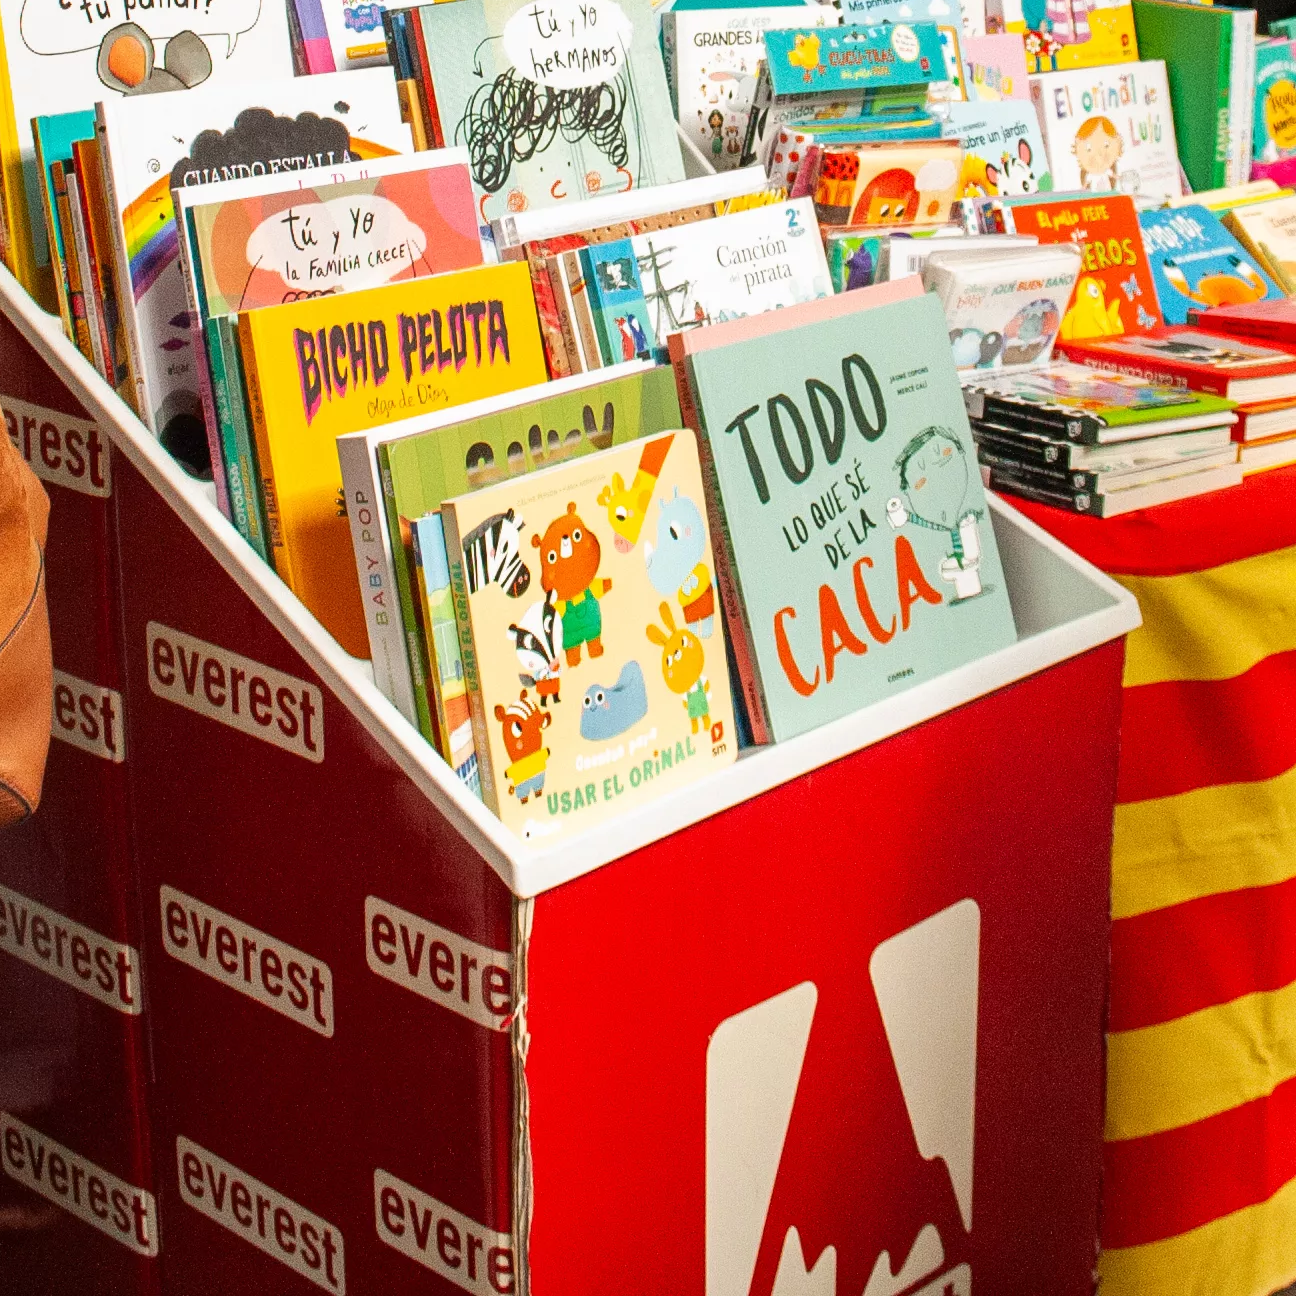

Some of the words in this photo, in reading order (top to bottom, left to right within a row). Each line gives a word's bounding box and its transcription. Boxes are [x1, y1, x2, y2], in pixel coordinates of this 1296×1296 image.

[80, 0, 111, 24] tu
[529, 4, 561, 39] tú
[849, 0, 864, 12] Mis
[693, 31, 752, 47] GRANDES
[1054, 84, 1073, 119] El
[1082, 73, 1137, 113] orinal
[988, 128, 1001, 144] un
[1001, 120, 1029, 144] jardín
[1129, 113, 1162, 147] Lulú
[281, 209, 318, 253] tú
[332, 228, 341, 254] y
[1082, 205, 1109, 223] PEPE
[285, 264, 301, 282] la
[716, 236, 787, 268] Canción
[744, 263, 793, 295] pirata
[1016, 279, 1043, 292] BUEN
[293, 318, 389, 427] BICHO
[396, 299, 511, 384] PELOTA
[367, 398, 397, 419] Olga
[399, 393, 415, 409] de
[725, 354, 887, 504] TODO
[354, 489, 376, 543] POP
[782, 515, 809, 552] LO
[811, 484, 841, 527] QUE
[845, 458, 871, 494] SÉ
[825, 538, 850, 570] DE
[853, 509, 877, 545] LA
[365, 555, 390, 626] BABY
[774, 535, 943, 696] CACA
[152, 633, 317, 753] everest
[547, 789, 597, 815] USAR
[603, 775, 624, 801] EL
[165, 898, 327, 1028] everest
[370, 910, 512, 1019] evere
[4, 1125, 151, 1250] everest
[183, 1146, 340, 1289] everest
[381, 1184, 514, 1295] evere
